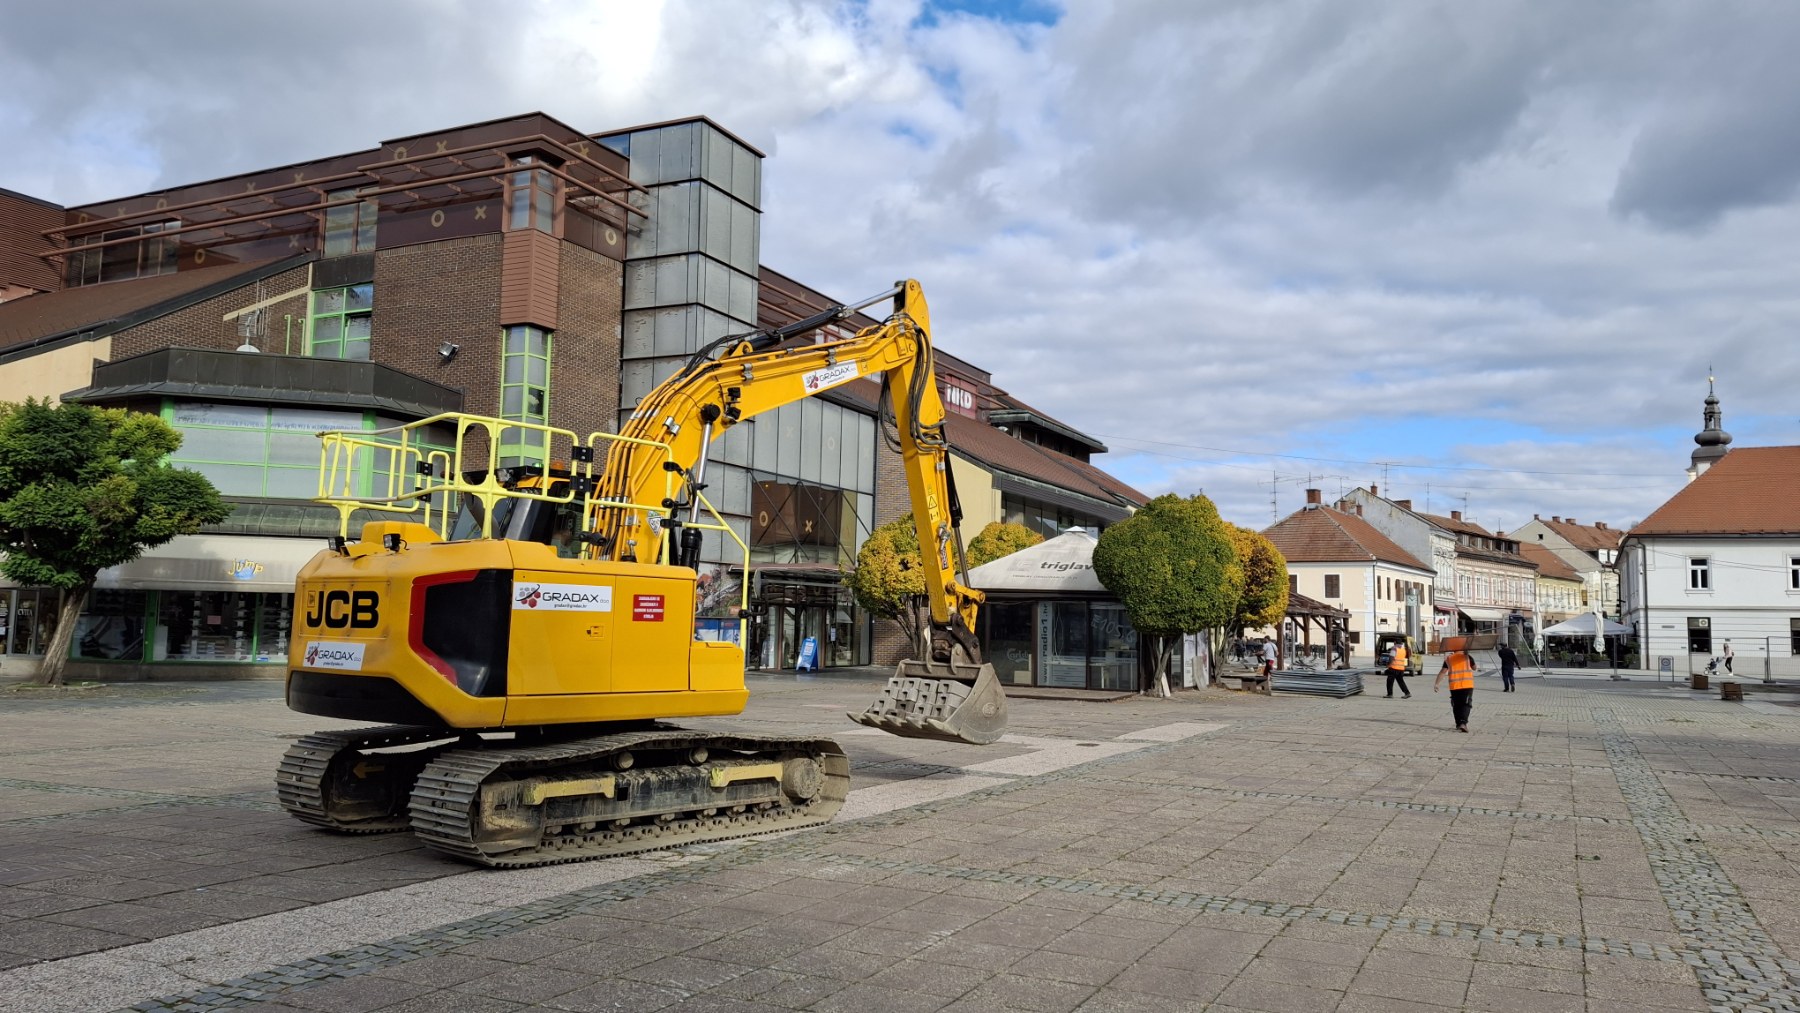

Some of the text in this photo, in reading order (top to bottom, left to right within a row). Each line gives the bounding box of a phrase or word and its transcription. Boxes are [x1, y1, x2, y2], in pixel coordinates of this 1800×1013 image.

[820, 365, 850, 381] GRADAX
[227, 558, 264, 576] jump
[1040, 561, 1094, 572] triglav
[542, 591, 599, 603] GRADAX
[306, 590, 379, 628] JCB
[318, 650, 355, 661] GRADAX
